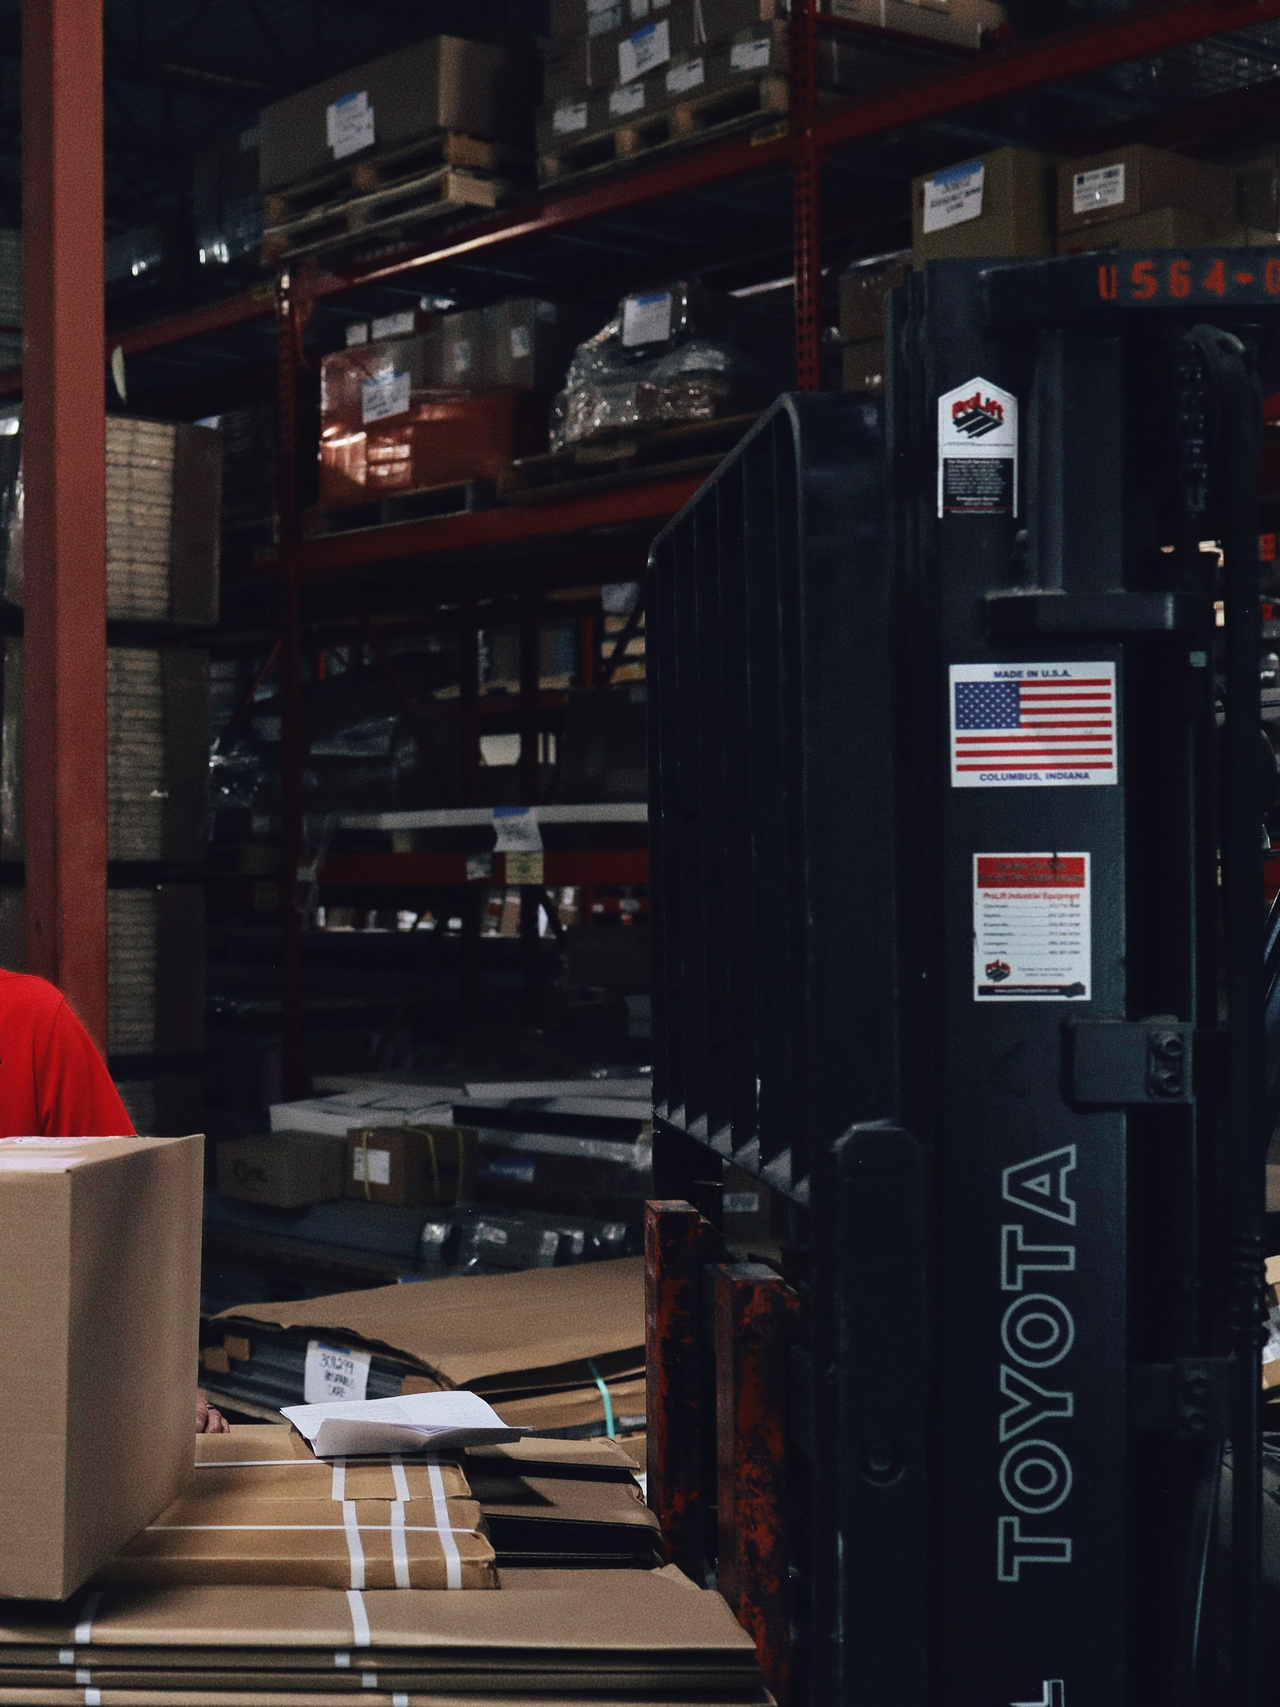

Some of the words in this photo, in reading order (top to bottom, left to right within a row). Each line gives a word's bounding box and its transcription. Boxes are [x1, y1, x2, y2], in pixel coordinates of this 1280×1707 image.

[993, 670, 1024, 679] MADE
[1027, 670, 1038, 678] IN
[1041, 669, 1072, 678] U.S.A.
[979, 772, 1043, 782] COLUMBUS,
[1045, 772, 1090, 781] INDIANA
[997, 1143, 1077, 1582] TOYOTA
